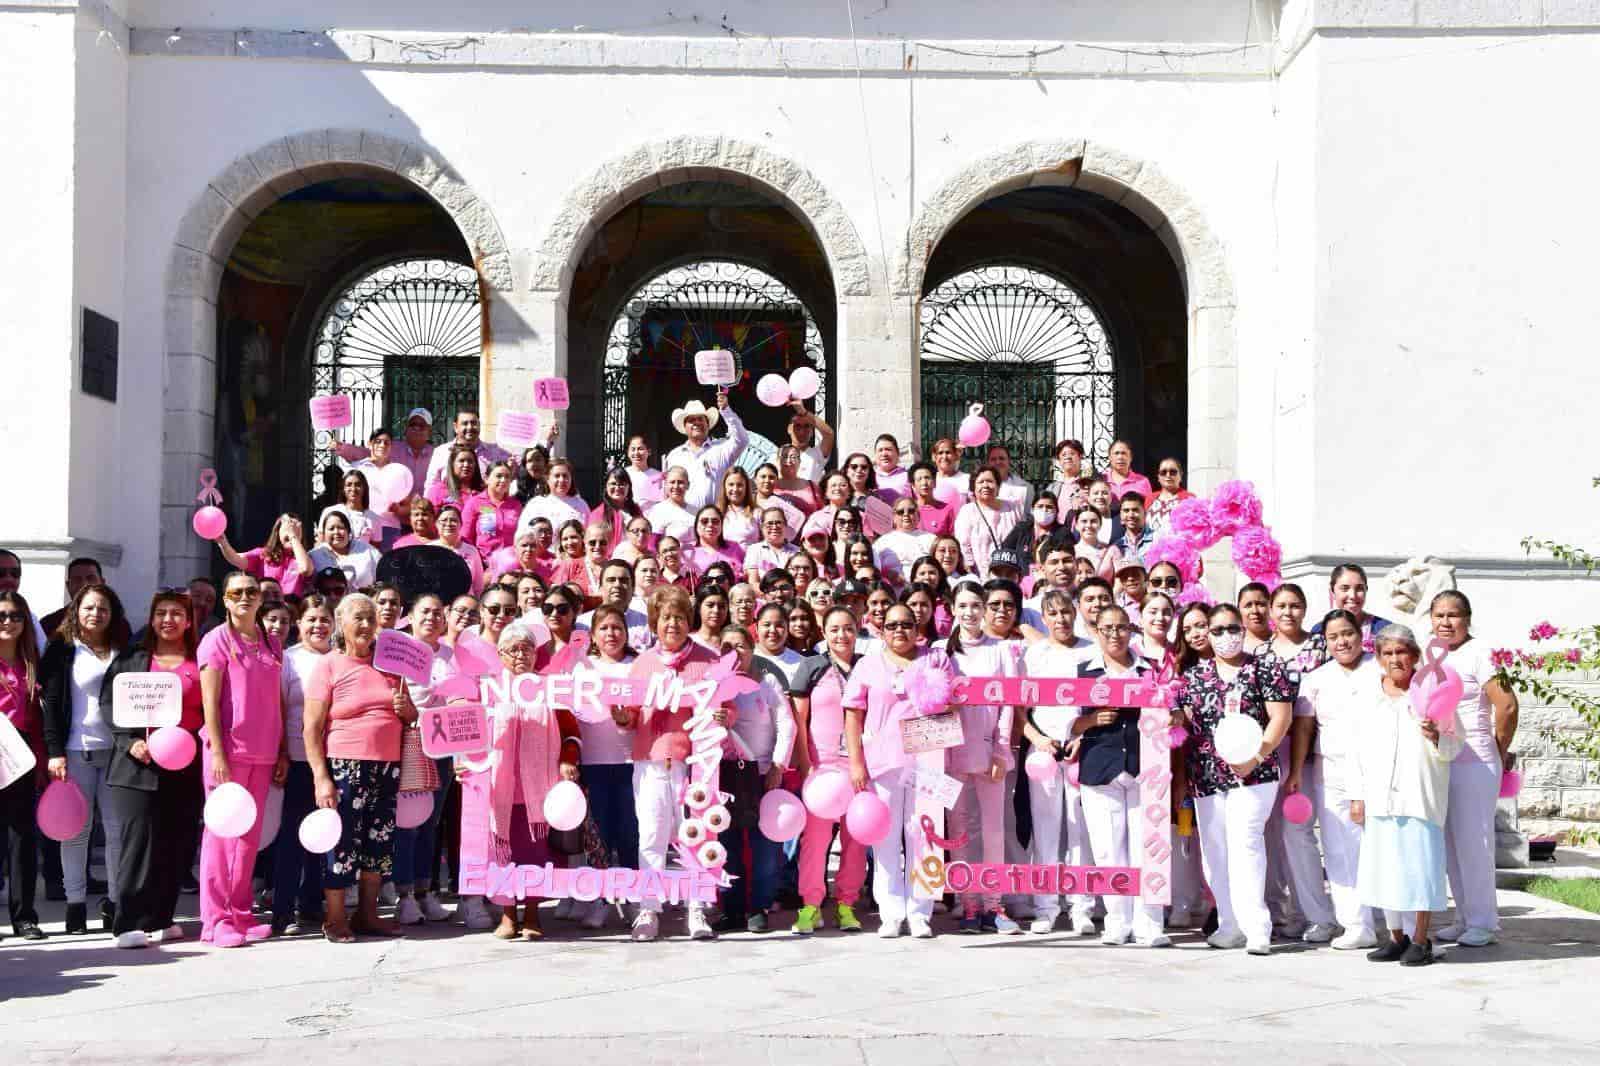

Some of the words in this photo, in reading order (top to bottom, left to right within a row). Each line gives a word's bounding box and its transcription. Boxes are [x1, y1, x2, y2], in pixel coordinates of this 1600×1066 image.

[610, 683, 633, 696] DE
[462, 862, 715, 904] EXPLORATE
[945, 860, 1130, 893] Octubre
